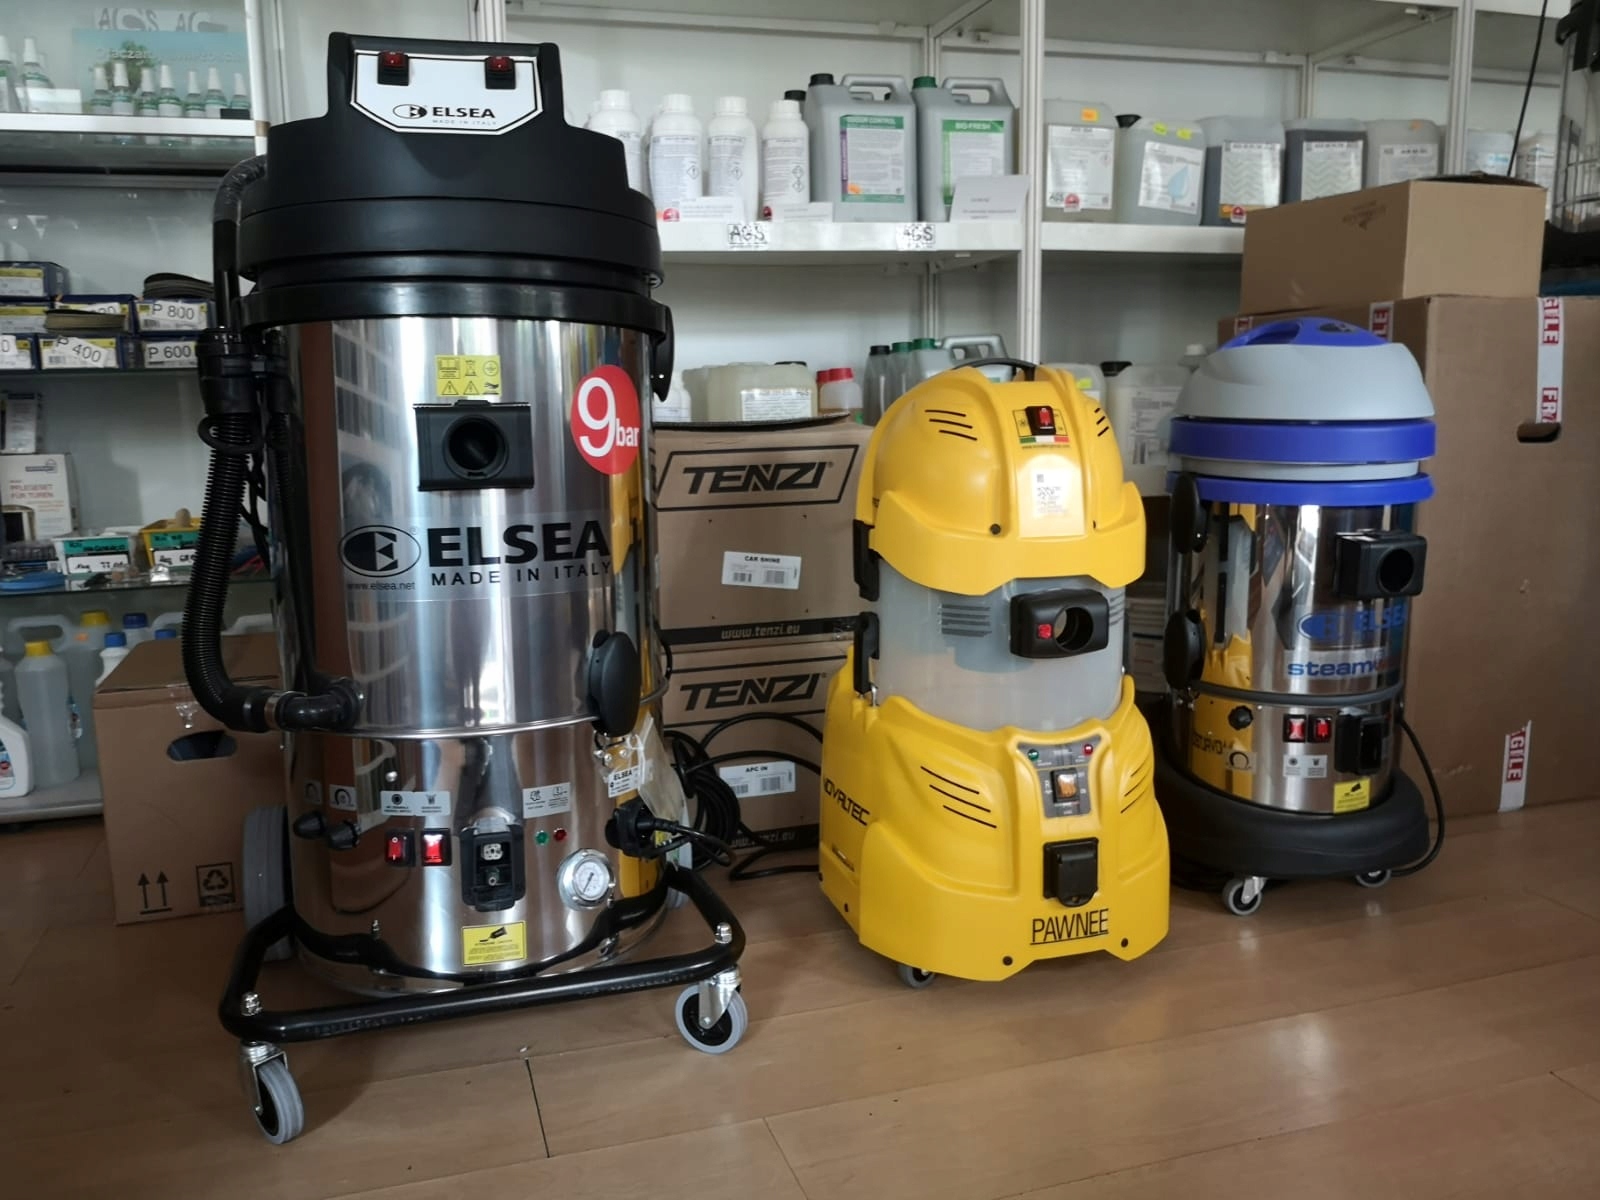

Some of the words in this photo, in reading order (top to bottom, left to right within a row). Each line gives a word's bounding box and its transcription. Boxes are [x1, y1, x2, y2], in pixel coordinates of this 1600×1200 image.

[432, 106, 495, 119] ELSEA
[152, 303, 163, 315] P
[168, 305, 194, 320] 800
[72, 344, 102, 363] 400
[148, 346, 159, 358] P
[163, 345, 191, 358] 600
[578, 377, 616, 457] 9
[616, 418, 640, 447] bar
[683, 462, 827, 494] TENZI
[427, 520, 610, 567] ELSEA
[431, 571, 501, 586] MADE
[517, 567, 539, 582] IN
[555, 561, 611, 579] ITALY
[346, 582, 416, 592] www.elsea.net
[721, 623, 800, 640] www.tenzi.eu
[680, 673, 821, 711] TENZI
[1031, 907, 1109, 943] PAWNEE
